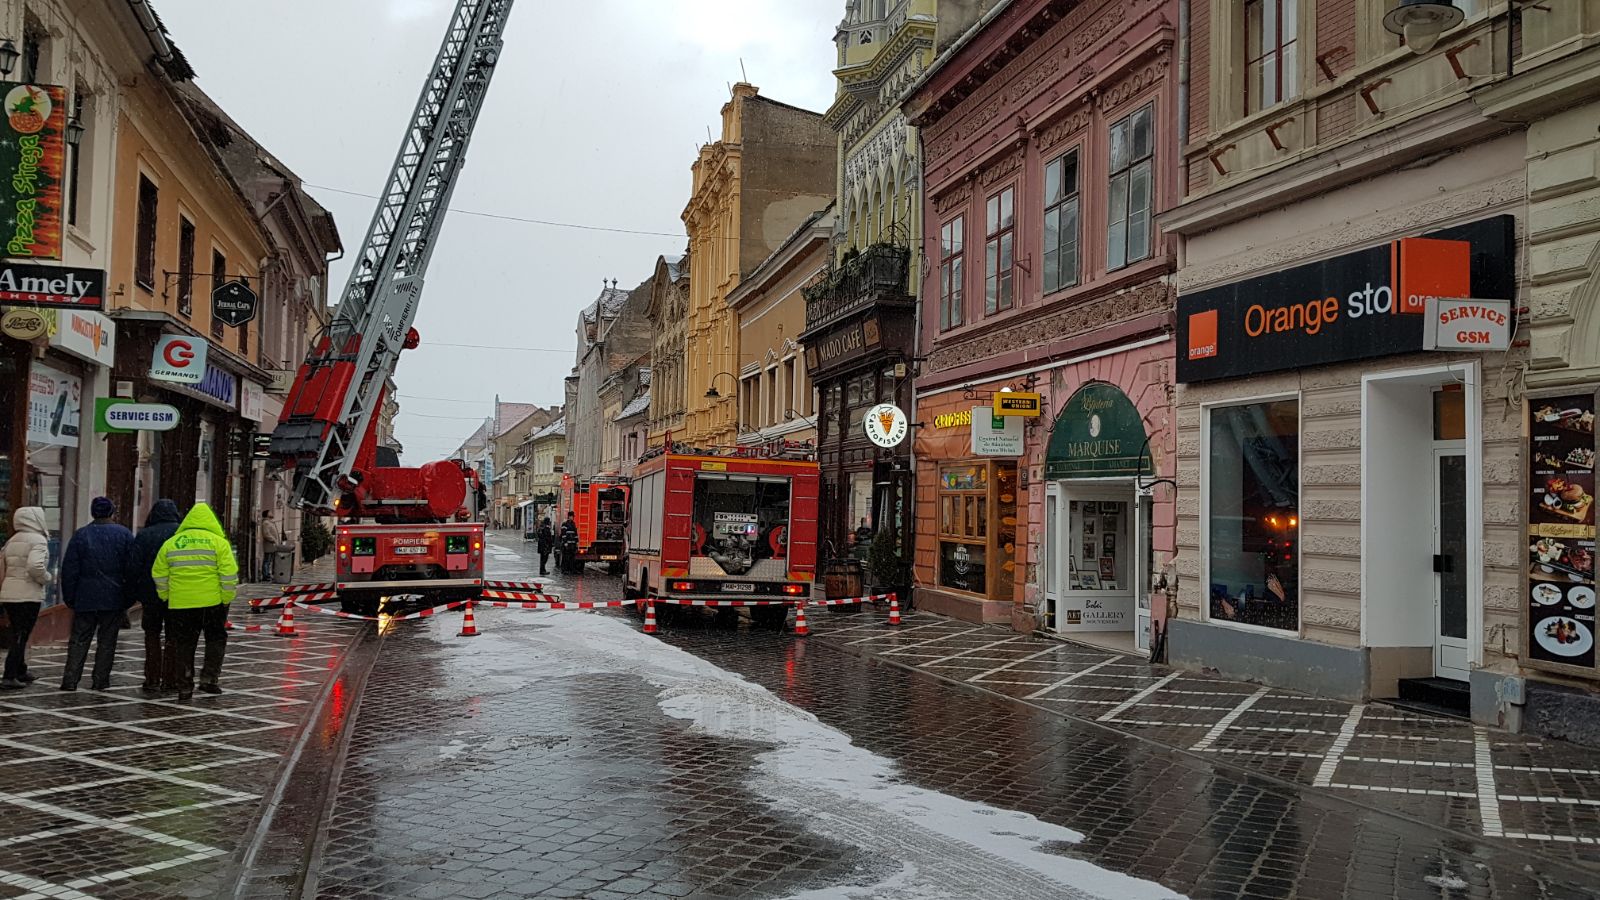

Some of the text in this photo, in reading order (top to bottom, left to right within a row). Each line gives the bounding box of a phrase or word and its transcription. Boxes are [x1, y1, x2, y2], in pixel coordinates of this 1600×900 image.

[7, 135, 44, 256] Pizza Strega
[0, 268, 93, 303] Amely
[0, 292, 71, 302] HOES
[1245, 282, 1392, 337] Orange sto
[1440, 306, 1507, 326] SERVICE
[820, 322, 861, 362] MADO CAFÉ
[1456, 331, 1490, 343] GSM
[1189, 344, 1214, 357] orange
[154, 369, 199, 380] GERMANOS
[110, 411, 173, 422] SERVICE GSM
[869, 413, 905, 444] CARTOFISSERIE
[1068, 439, 1122, 457] MARQUISE
[1083, 611, 1126, 619] GALLERY
